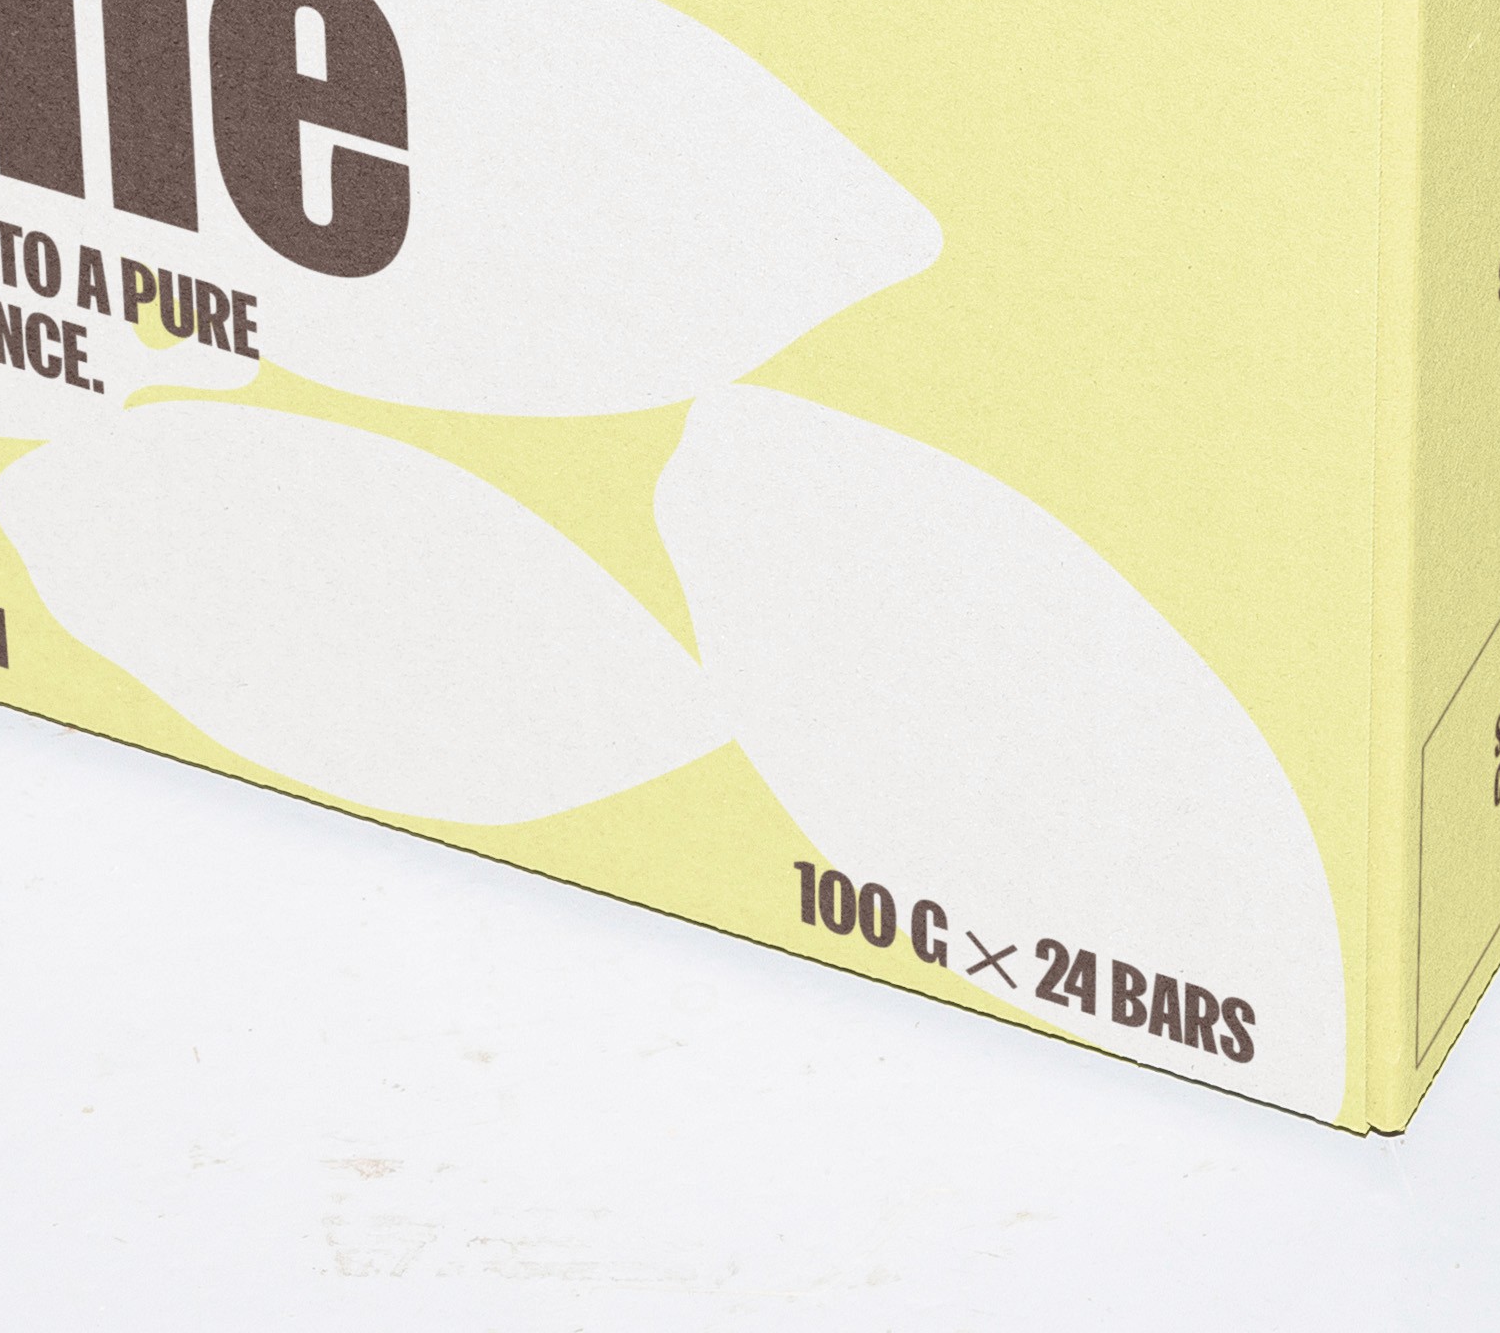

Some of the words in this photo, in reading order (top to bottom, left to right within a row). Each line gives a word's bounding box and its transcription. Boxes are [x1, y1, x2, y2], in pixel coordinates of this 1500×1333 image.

[77, 245, 111, 315] A
[121, 257, 259, 360] PURE
[794, 861, 896, 948] 100
[911, 900, 947, 968] G
[1036, 938, 1096, 1015] 24
[1112, 960, 1255, 1063] BARS
